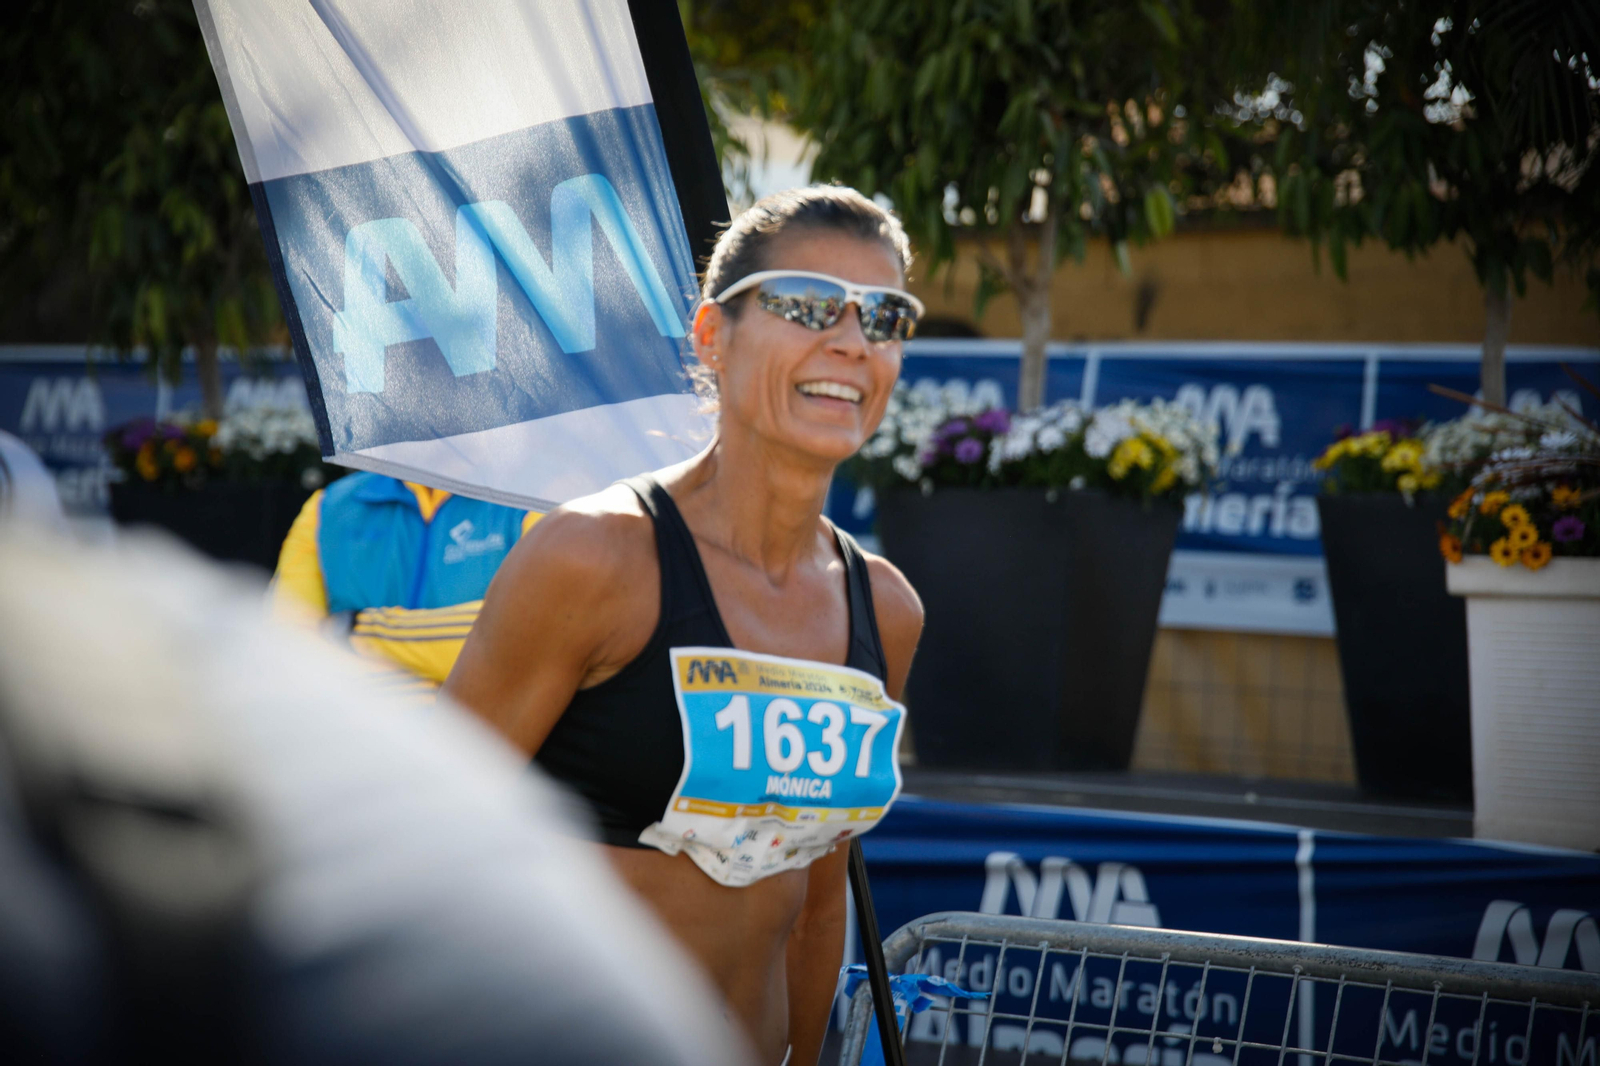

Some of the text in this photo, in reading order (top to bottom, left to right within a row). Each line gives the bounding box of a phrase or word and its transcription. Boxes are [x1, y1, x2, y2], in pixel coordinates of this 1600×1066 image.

[714, 694, 889, 778] 1637
[765, 772, 833, 799] MÓNICA
[1050, 961, 1238, 1026] Maratón
